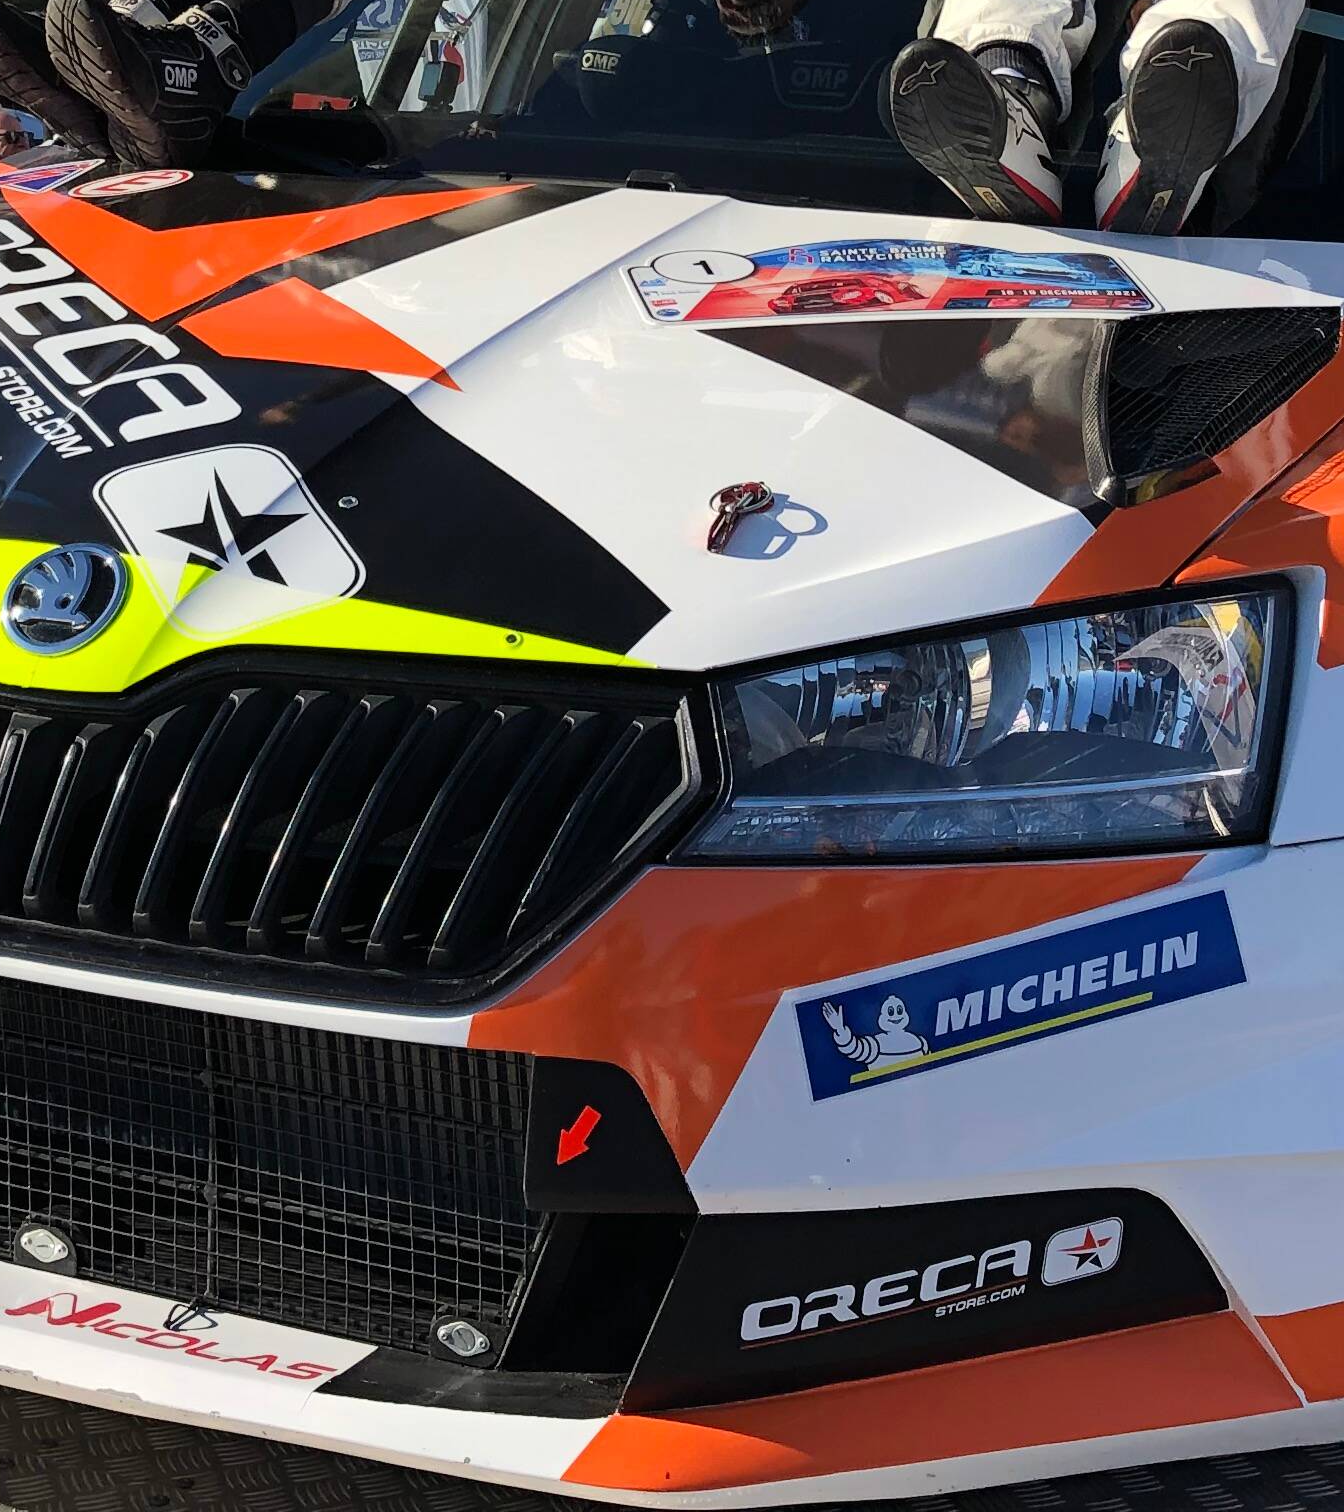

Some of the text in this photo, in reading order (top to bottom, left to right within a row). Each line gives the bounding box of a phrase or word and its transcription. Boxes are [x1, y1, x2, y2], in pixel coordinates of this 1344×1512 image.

[185, 13, 221, 40] OMP
[582, 52, 619, 70] OMP
[164, 63, 198, 88] OMP
[692, 259, 715, 275] 1
[819, 252, 946, 263] RALLYCIRCUIT
[933, 931, 1199, 1036] MICHELIN
[739, 1239, 1032, 1342] ORECA
[934, 1283, 1026, 1318] STORE.COM
